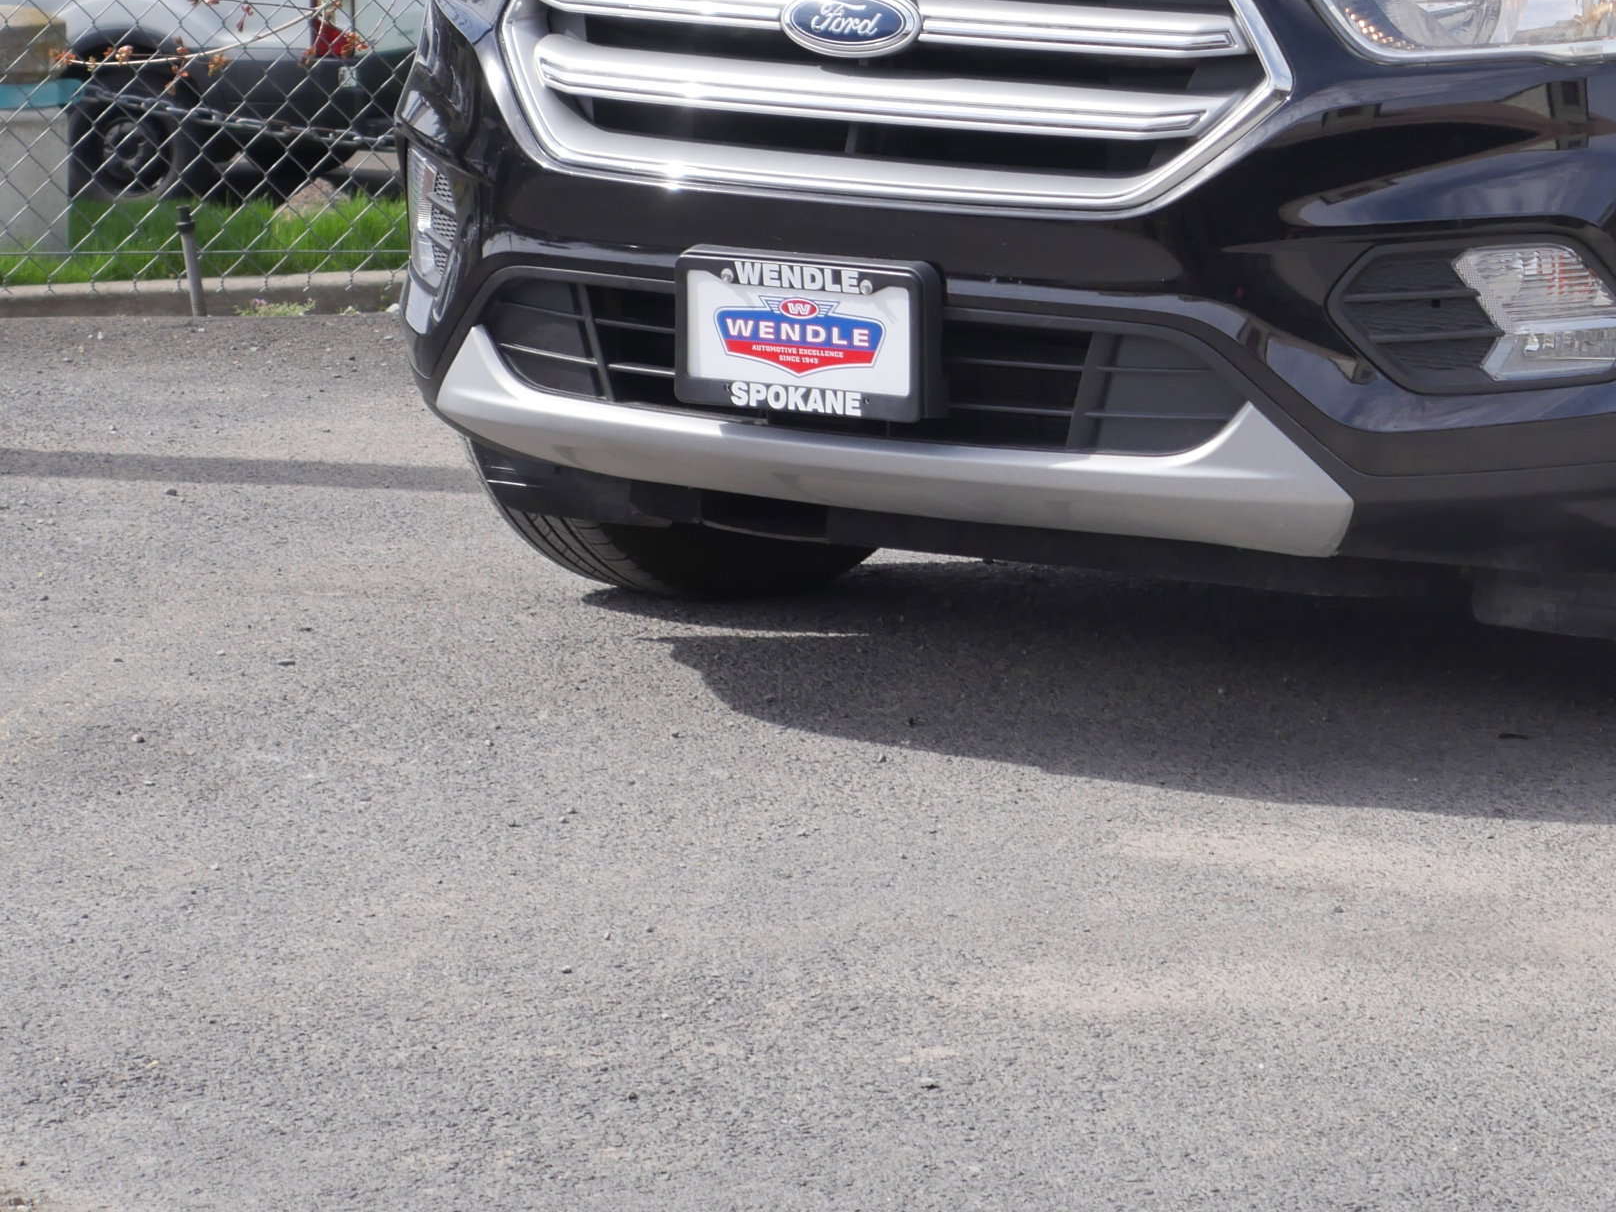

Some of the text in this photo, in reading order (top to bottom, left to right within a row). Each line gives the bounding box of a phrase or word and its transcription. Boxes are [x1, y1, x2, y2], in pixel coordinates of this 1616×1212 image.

[810, 0, 883, 37] Ford
[734, 261, 861, 294] WENDLE
[725, 317, 870, 347] WENDLE
[751, 344, 844, 358] AUTOMOTIVE EXCELLENCE
[778, 354, 800, 363] SINCE
[730, 380, 862, 417] SPOKANE
